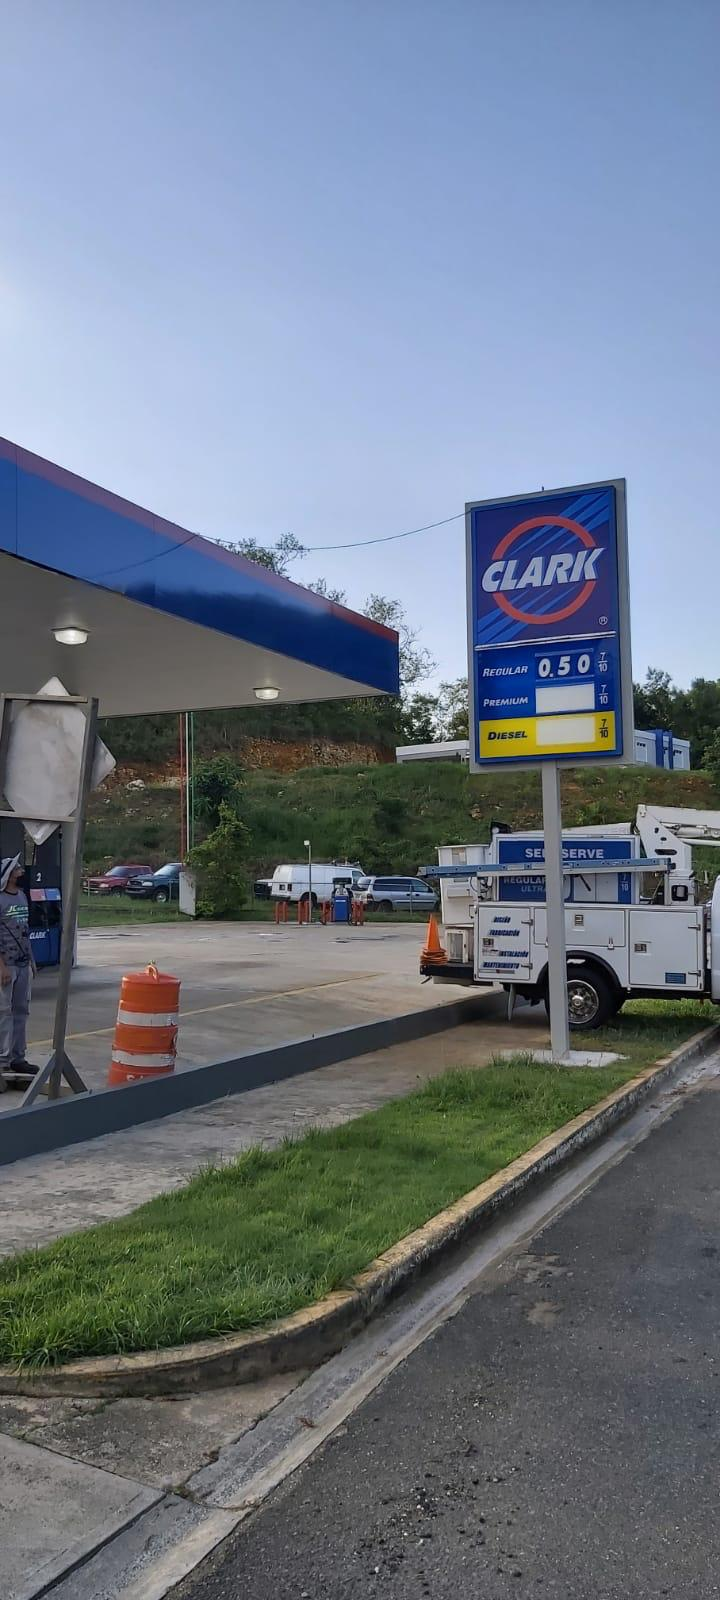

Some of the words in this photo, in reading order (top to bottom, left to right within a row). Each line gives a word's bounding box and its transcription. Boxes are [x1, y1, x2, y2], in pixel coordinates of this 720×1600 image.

[482, 548, 605, 592] CLARK
[482, 665, 528, 677] REGULAR
[483, 696, 528, 707] PREMIUM
[487, 730, 528, 740] DIESEL
[562, 849, 604, 858] SERVE
